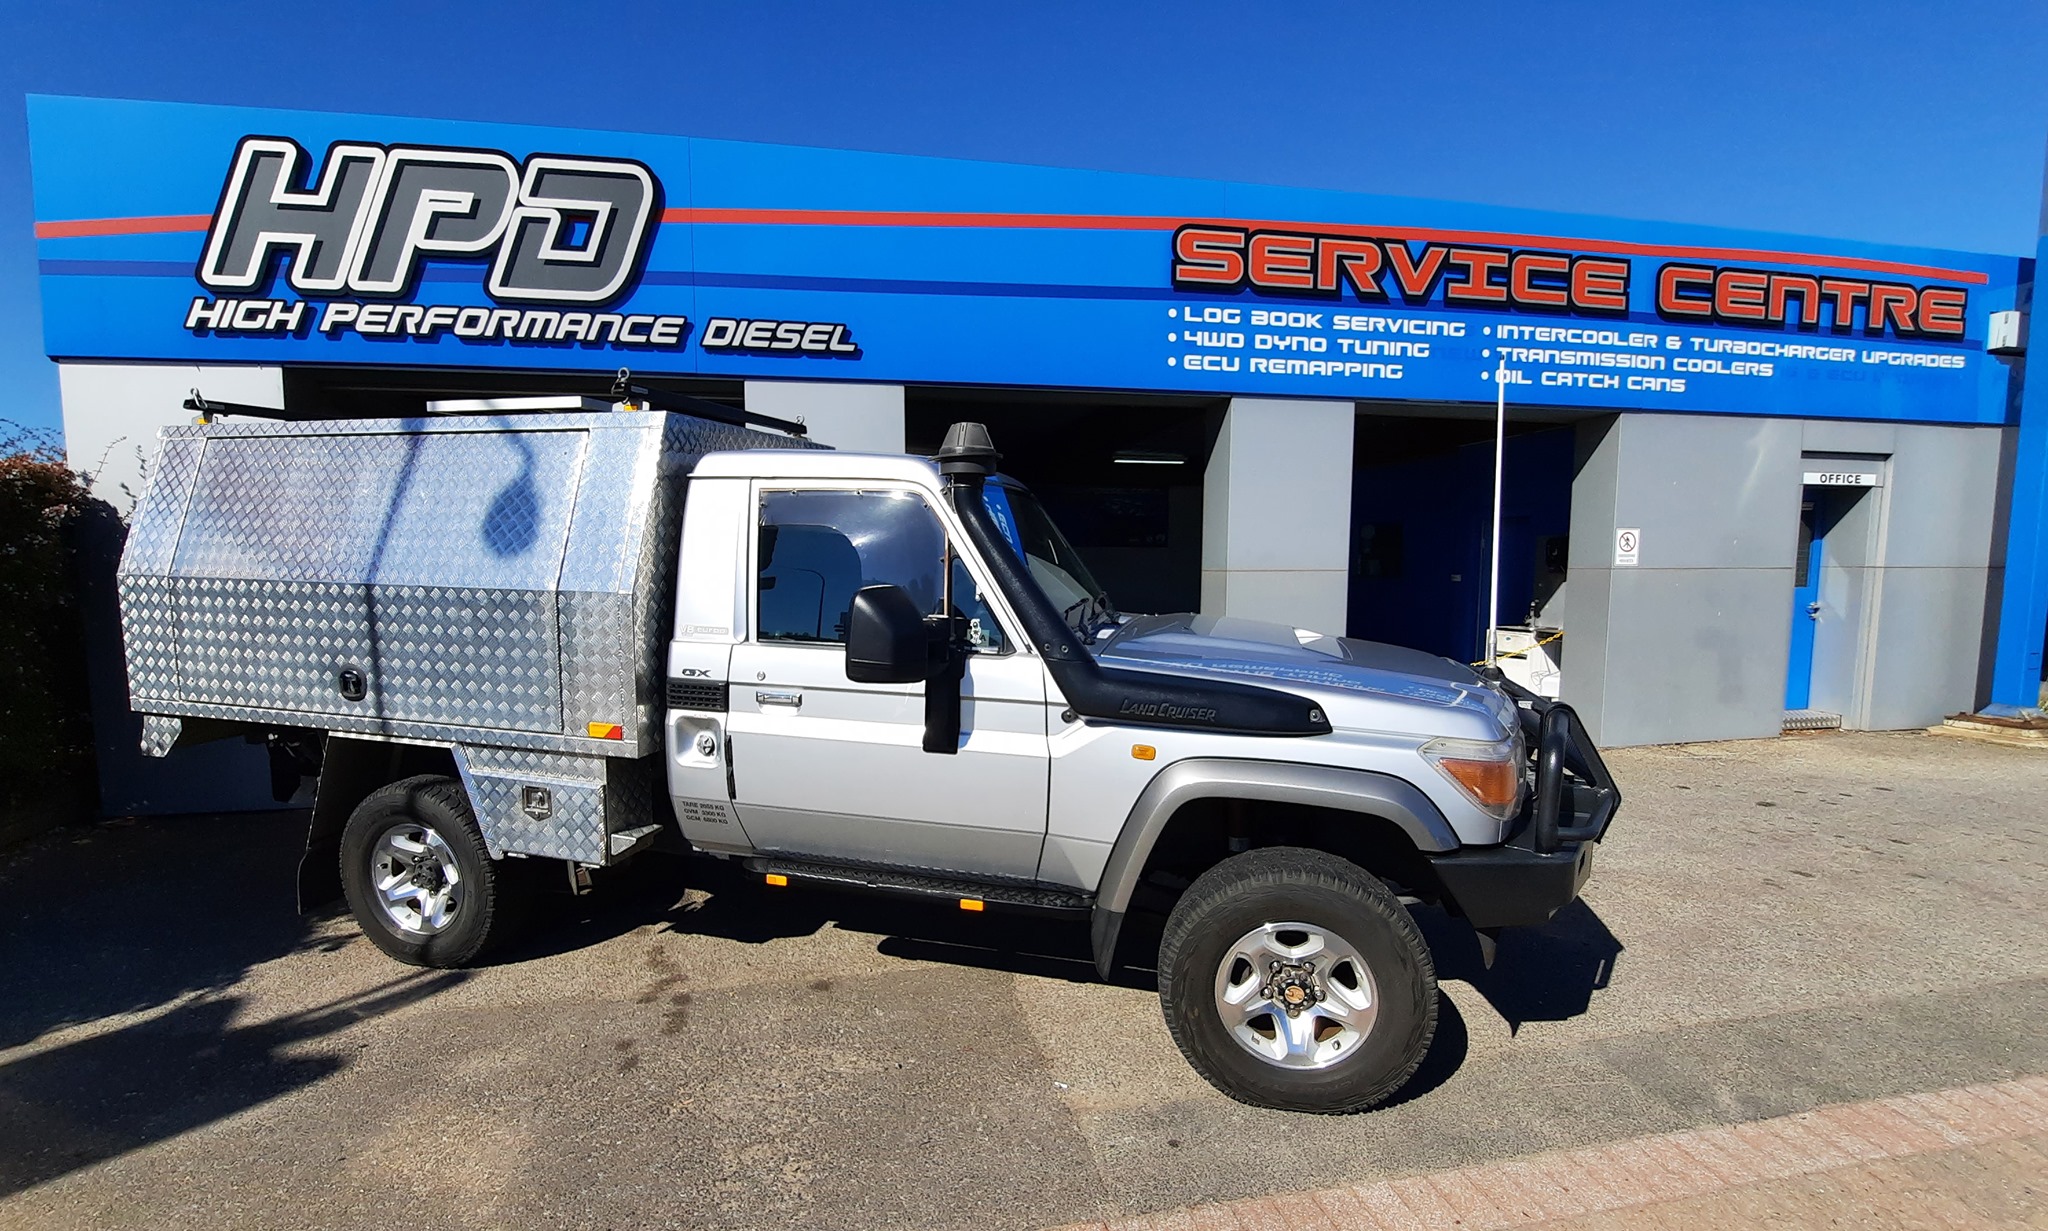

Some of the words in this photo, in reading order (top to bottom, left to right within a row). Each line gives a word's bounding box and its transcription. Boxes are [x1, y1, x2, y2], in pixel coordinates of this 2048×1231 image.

[199, 136, 657, 303] HPD
[1175, 227, 1629, 312] SERVICE
[1658, 264, 1967, 336] CENTRE
[184, 299, 304, 331] HIGH
[319, 303, 685, 345] PERFORMANCE
[702, 319, 857, 352] DIESEL
[1184, 306, 1241, 324] LOG
[1251, 310, 1323, 329] BOOK
[1333, 315, 1466, 337] SERVICING
[1184, 330, 1245, 348] 4WD
[1254, 334, 1327, 352] DYNO
[1337, 338, 1430, 358] TUNING
[1496, 324, 1657, 348] INTERCOOLER
[1665, 334, 1682, 350] &
[1689, 337, 1856, 362] TURBOCHARGER
[1862, 350, 1965, 369] UPGRADES
[1183, 354, 1240, 372] ECU
[1250, 357, 1403, 379] REMAPPING
[1496, 346, 1666, 371] TRANSMISSION
[1673, 357, 1774, 377] COOLERS
[1494, 369, 1533, 385] OIL
[1541, 371, 1620, 389] CATCH
[1627, 376, 1686, 393] CANS
[1819, 473, 1862, 484] OFFICE
[681, 668, 712, 678] GX
